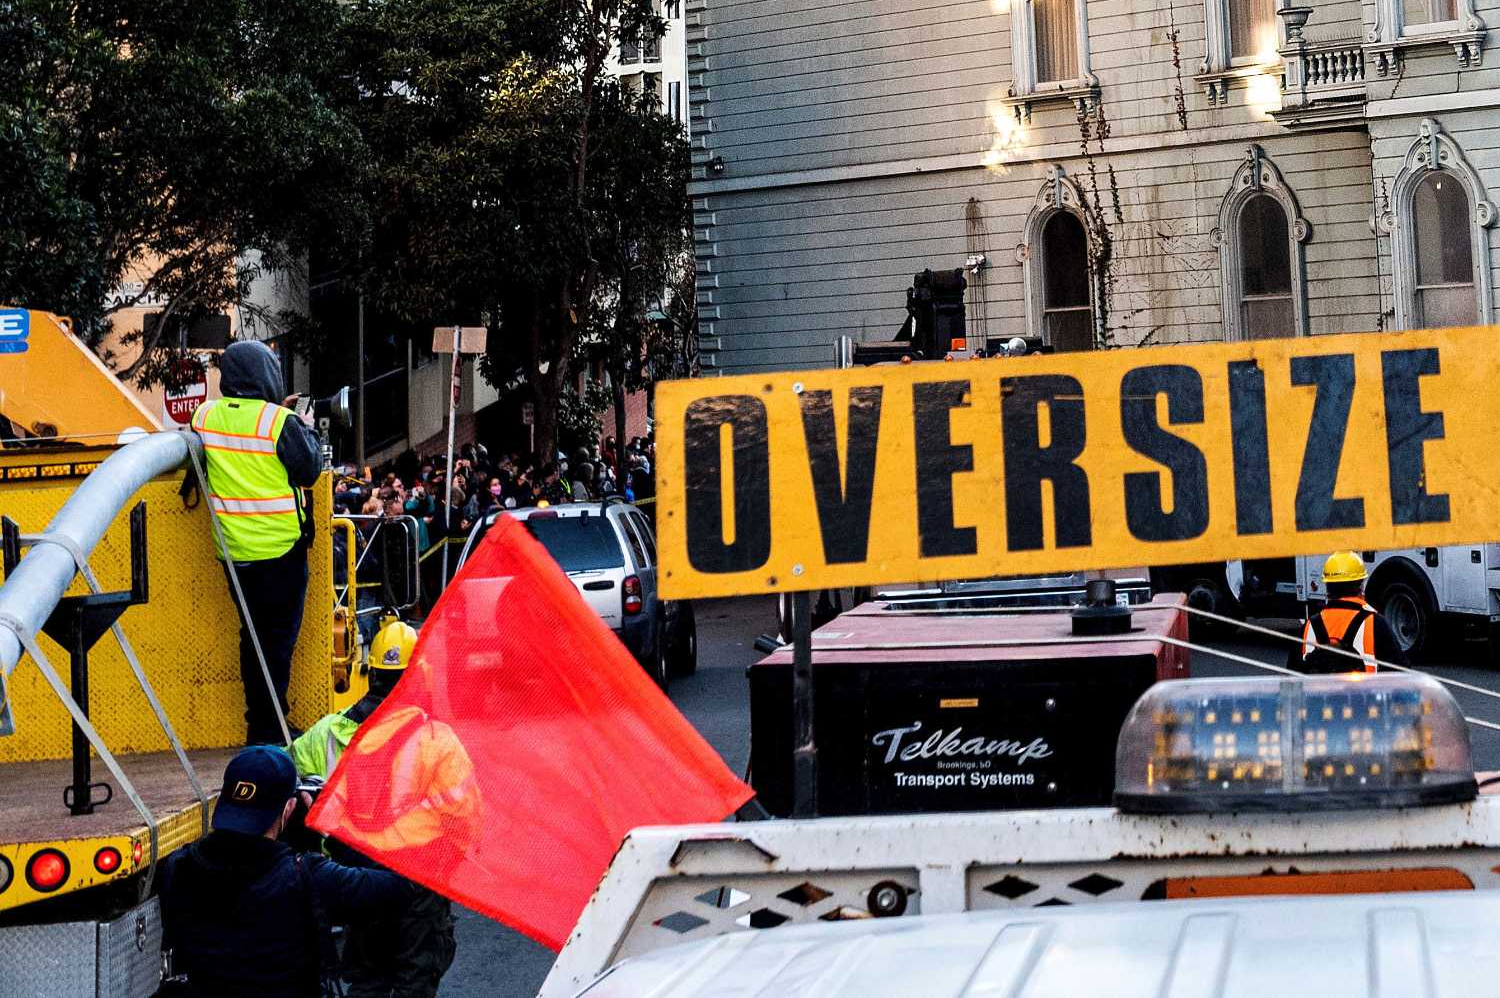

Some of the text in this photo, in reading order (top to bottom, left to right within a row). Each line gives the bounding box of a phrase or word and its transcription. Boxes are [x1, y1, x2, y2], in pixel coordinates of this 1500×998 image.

[171, 398, 200, 414] ENTER
[685, 344, 1452, 574] OVERSIZE
[872, 721, 1053, 766] Telkamp
[894, 771, 1035, 789] Transport Systems
